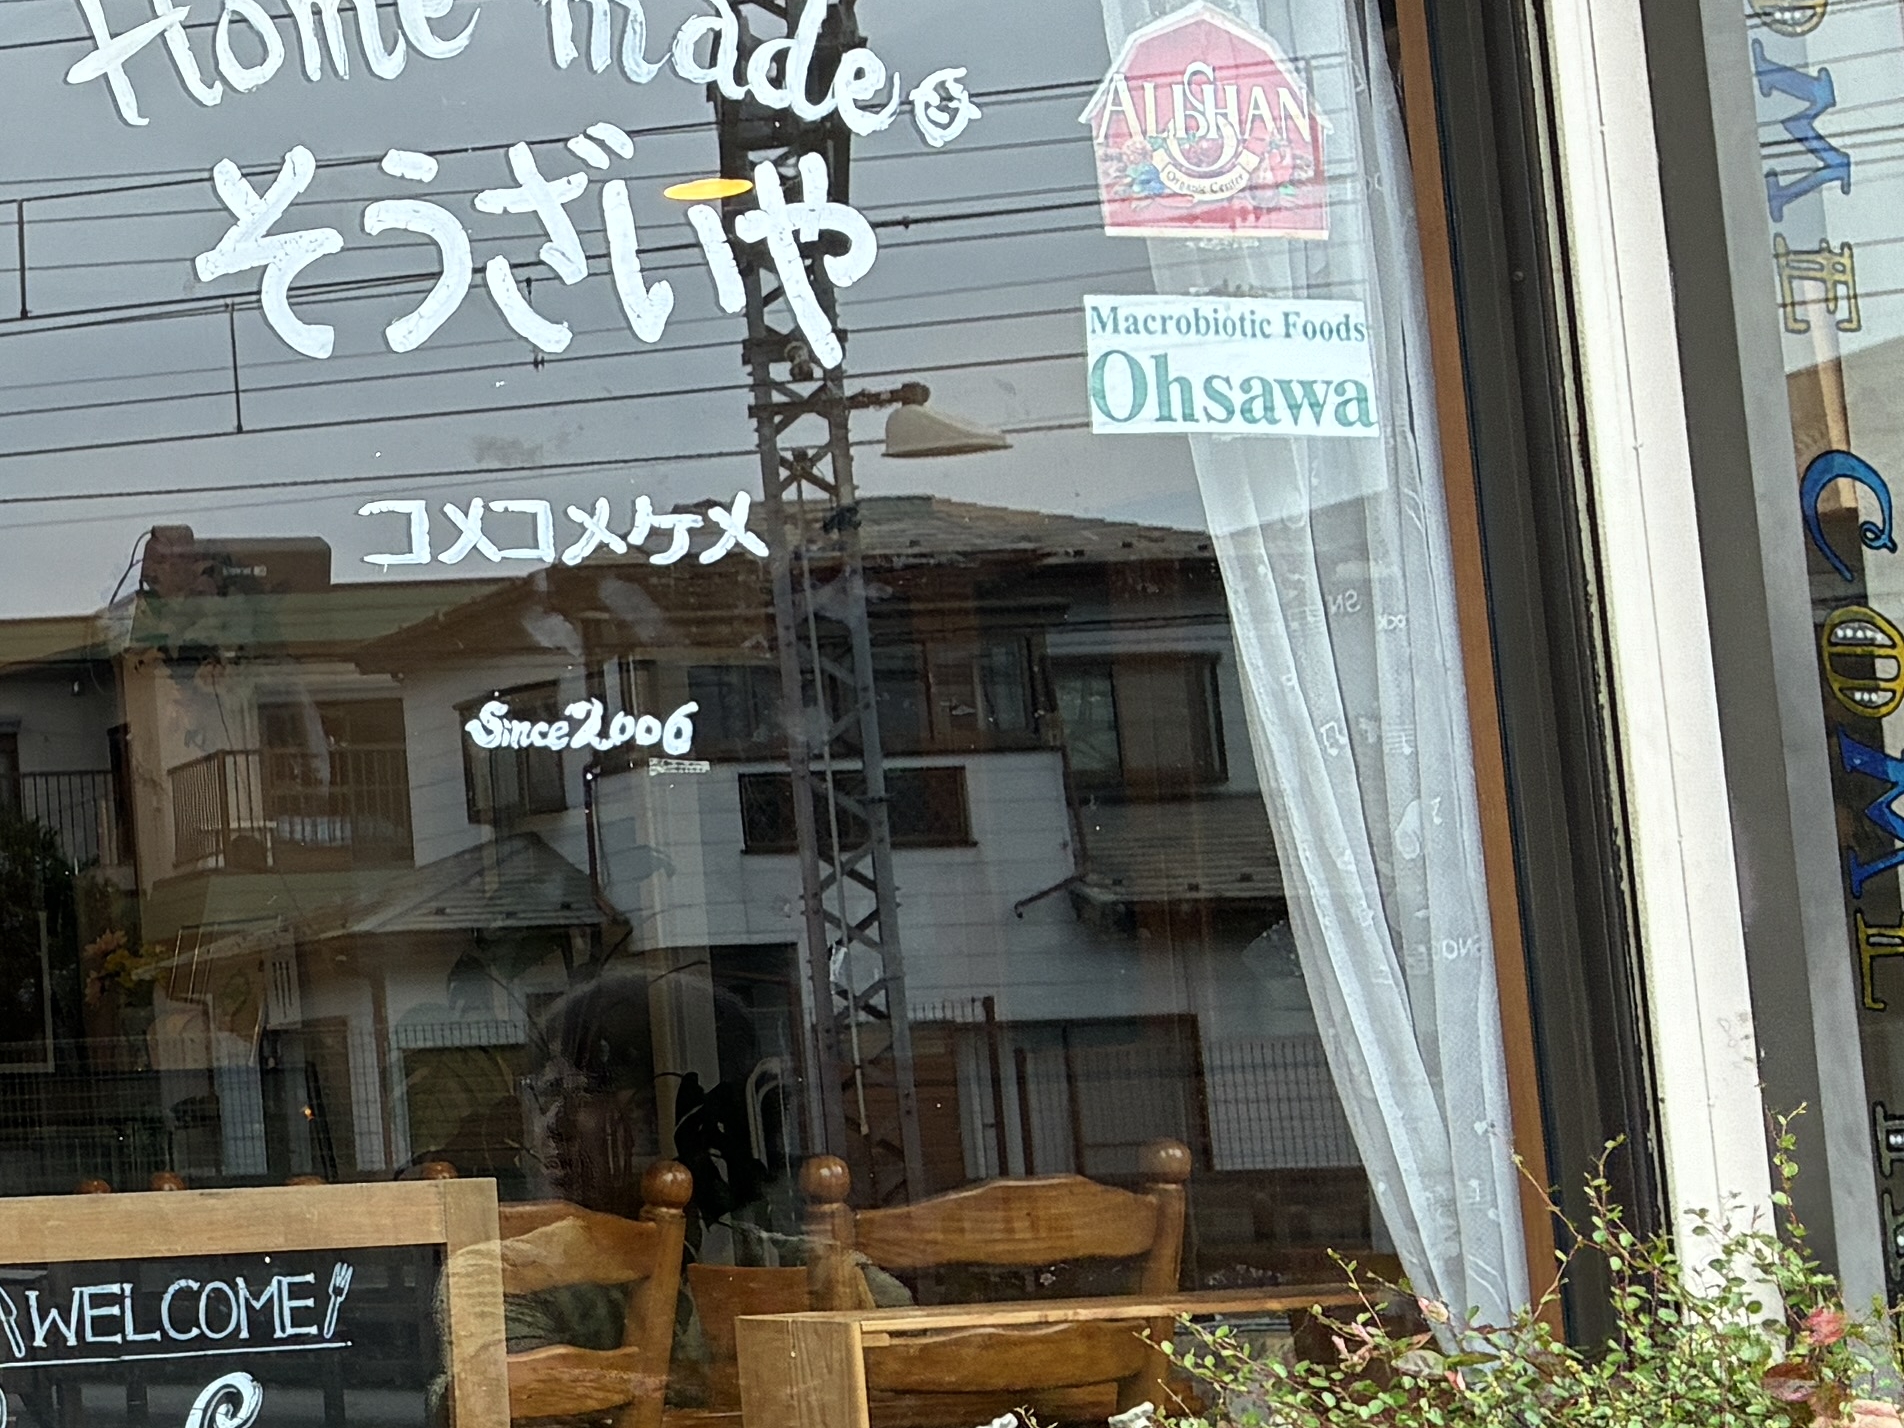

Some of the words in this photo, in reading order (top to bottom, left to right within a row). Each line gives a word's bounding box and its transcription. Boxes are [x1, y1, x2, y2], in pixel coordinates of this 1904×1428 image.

[1096, 61, 1313, 172] ALISHAN
[195, 122, 878, 370] そうざいや
[1090, 305, 1272, 340] Macrobiotic
[1281, 310, 1367, 344] Foods
[1090, 348, 1379, 429] Ohsawa
[357, 490, 769, 565] コメコメケメ
[24, 1271, 318, 1349] WELCOME
